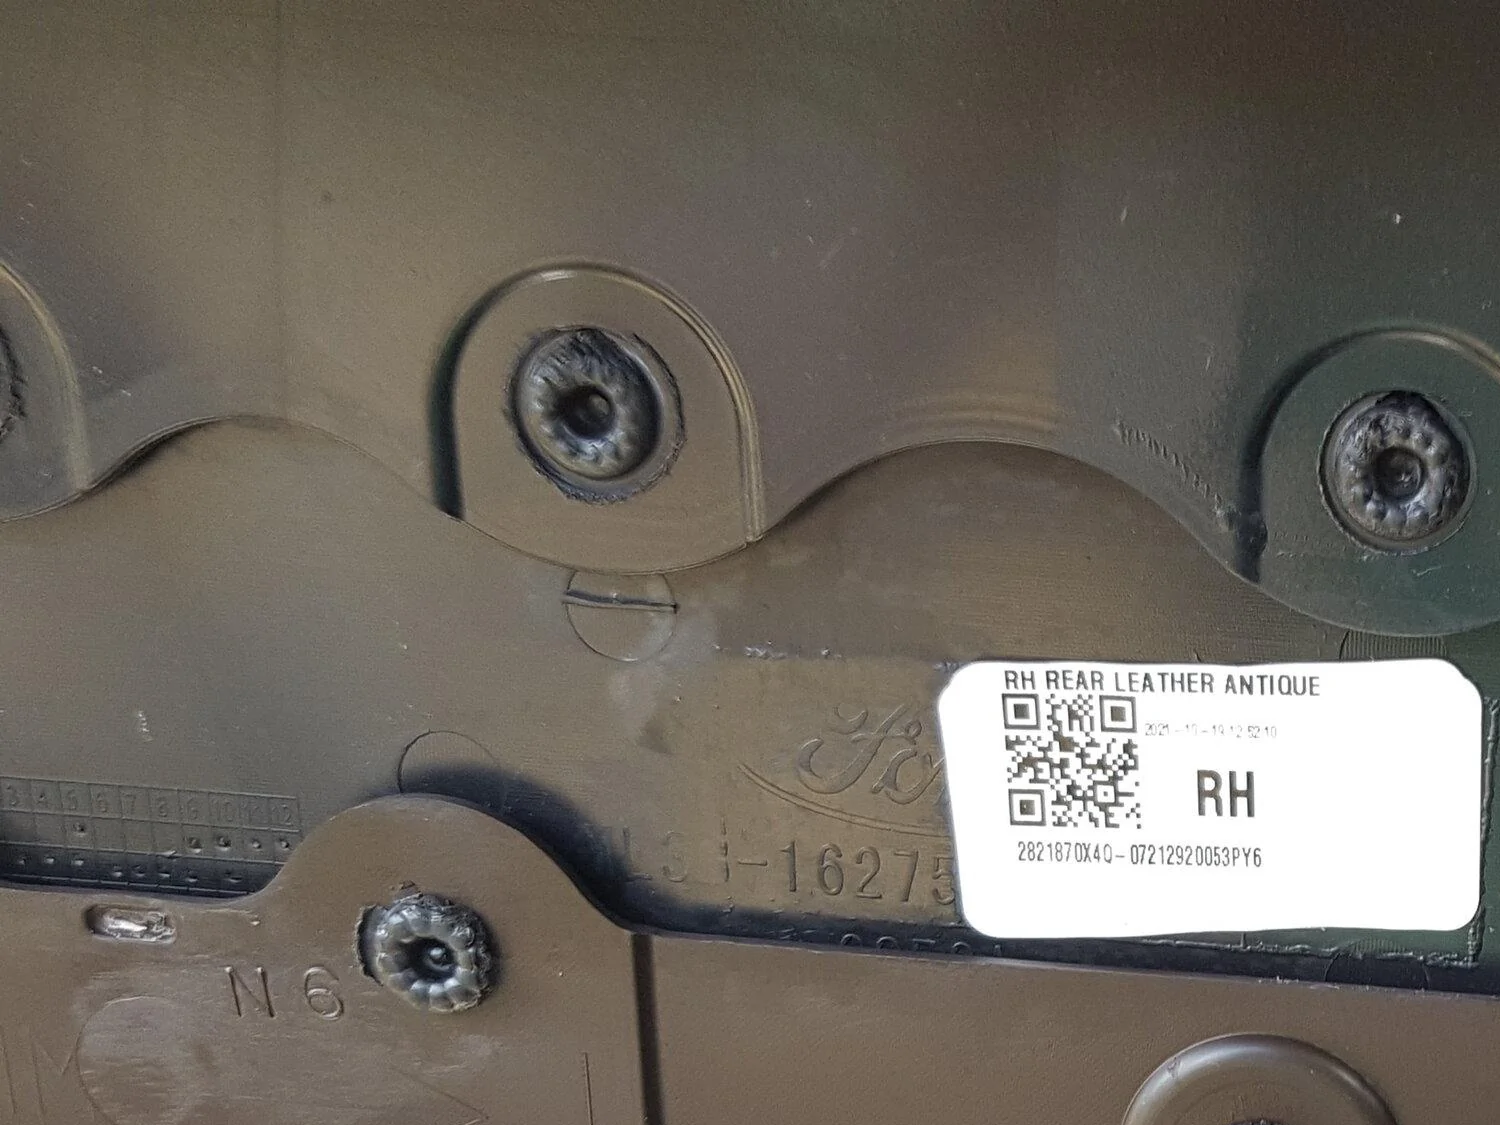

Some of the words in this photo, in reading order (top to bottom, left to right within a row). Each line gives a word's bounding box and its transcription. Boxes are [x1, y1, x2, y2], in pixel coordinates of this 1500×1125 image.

[1005, 670, 1035, 690] RH
[1046, 670, 1104, 691] REAR
[1115, 672, 1215, 693] LEATHER
[1225, 674, 1320, 696] ANTIQUE
[1197, 769, 1255, 818] RH
